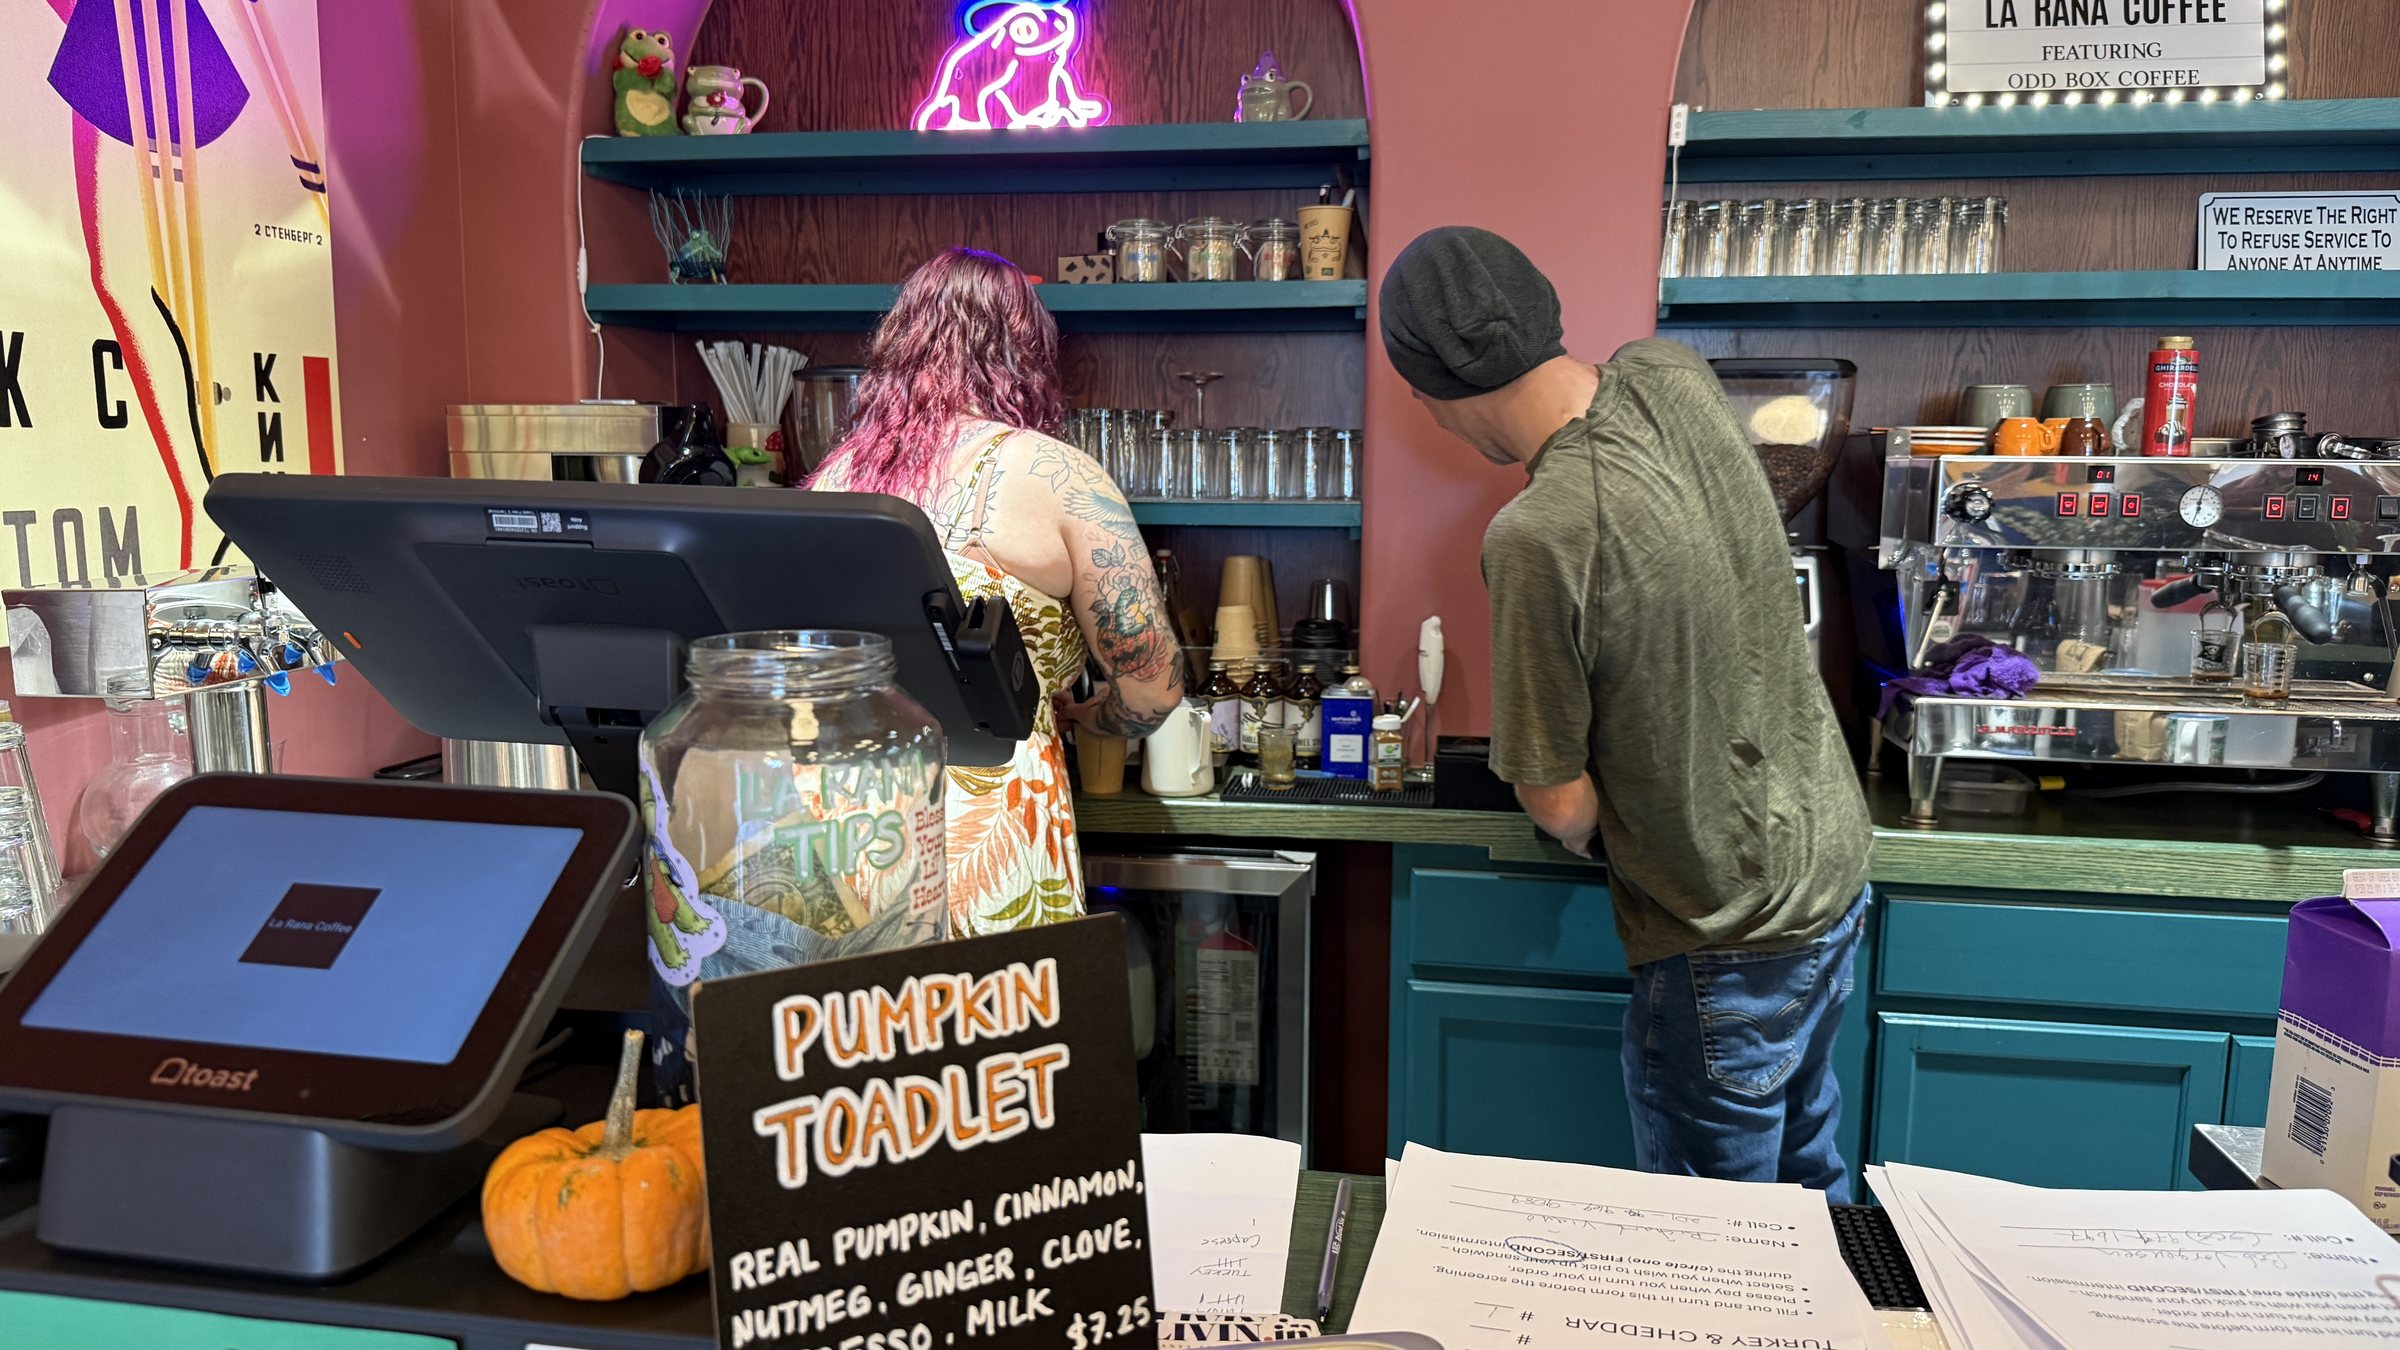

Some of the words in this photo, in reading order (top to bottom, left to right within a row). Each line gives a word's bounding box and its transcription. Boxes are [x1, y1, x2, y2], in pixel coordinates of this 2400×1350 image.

[1986, 0, 2017, 28] LA
[2034, 0, 2109, 26] RANA
[2123, 0, 2227, 25] COFFEE
[2041, 42, 2162, 61] FEATURING
[2008, 73, 2056, 89] ODD
[2066, 71, 2110, 88] BOX
[2118, 69, 2200, 86] COFFEE
[2213, 207, 2240, 225] WE
[254, 223, 261, 236] 2
[265, 225, 313, 243] СТЕНБЕРГ
[316, 235, 323, 245] 2
[253, 352, 286, 475] КИ
[773, 810, 906, 884] TIPS
[268, 918, 283, 928] La
[284, 919, 314, 930] Rana
[314, 920, 353, 934] Coffee
[772, 957, 1060, 1082] PUMPKIN
[182, 1062, 260, 1092] toast
[752, 1043, 1070, 1188] TOADLET
[729, 1238, 820, 1292] REAL
[994, 1159, 1144, 1227] CINNAMON,
[1747, 1220, 1782, 1231] Cell
[1041, 1217, 1142, 1270] CLOVE,
[1416, 1227, 1505, 1248] intermission.
[1726, 1234, 1786, 1248] Name:
[1452, 1246, 1521, 1262] sandwich
[1509, 1243, 1623, 1263] FIRST/SECOND
[2303, 1251, 2368, 1265] Name:
[1523, 1256, 1557, 1265] your
[1559, 1260, 1578, 1269] up
[1627, 1255, 1662, 1266] one)
[1666, 1260, 1714, 1273] (circle
[1432, 1265, 1507, 1284] screening.
[1507, 1265, 1549, 1277] order.
[1580, 1263, 1613, 1274] pick
[1616, 1266, 1631, 1274] to
[1634, 1268, 1668, 1278] wish
[1717, 1266, 1741, 1276] the
[1744, 1268, 1792, 1280] during
[1552, 1271, 1586, 1281] your
[1588, 1275, 1601, 1284] in
[1605, 1276, 1635, 1287] turn
[1671, 1271, 1699, 1281] you
[1701, 1276, 1743, 1286] when
[1511, 1277, 1535, 1288] the
[1538, 1282, 1586, 1294] before
[1639, 1280, 1667, 1289] you
[1745, 1281, 1795, 1292] Select
[1590, 1287, 1625, 1299] form
[1672, 1284, 1711, 1295] when
[1714, 1288, 1742, 1298] pay
[1629, 1291, 1657, 1301] this
[1661, 1295, 1674, 1303] in
[1678, 1296, 1710, 1306] turn
[1745, 1293, 1797, 1304] Please
[1714, 1300, 1743, 1310] and
[1749, 1304, 1772, 1313] out
[966, 1286, 1055, 1338] MILK
[1776, 1307, 1798, 1317] Fill
[1065, 1295, 1151, 1350] $7.25
[1566, 1316, 1698, 1343] CHEDDAR
[1705, 1332, 1723, 1345] &
